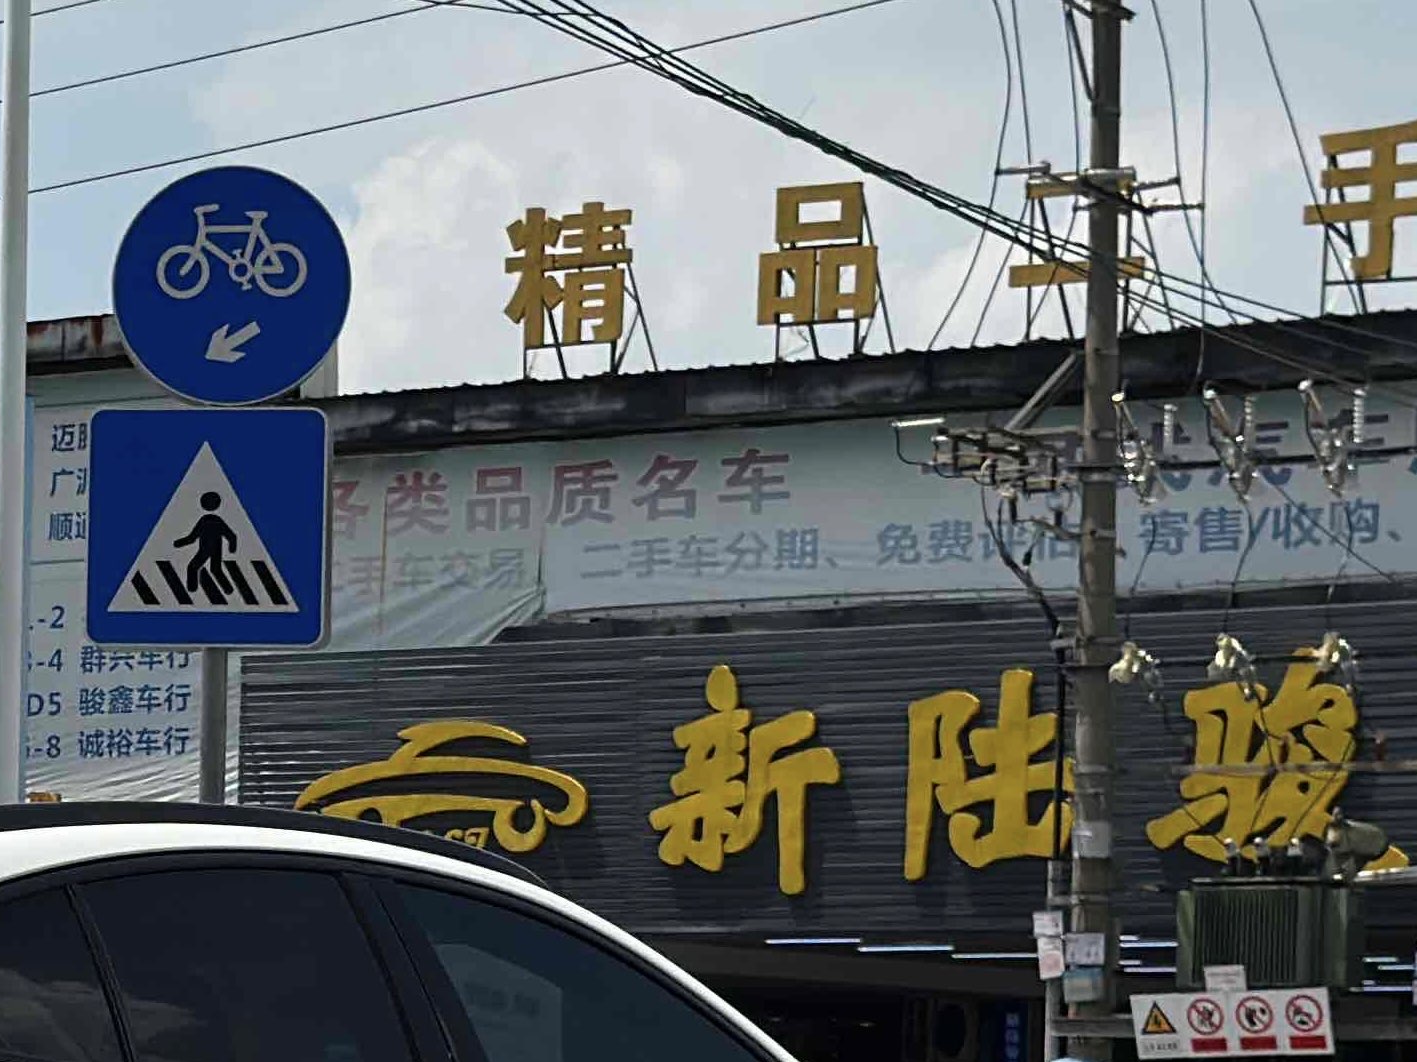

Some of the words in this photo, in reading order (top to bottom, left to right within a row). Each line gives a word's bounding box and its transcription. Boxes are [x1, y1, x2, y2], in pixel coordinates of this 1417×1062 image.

[332, 448, 791, 539] 各类品质名车
[29, 605, 66, 630] -2
[78, 683, 192, 717] 骏鑫车行
[25, 734, 62, 759] -8
[76, 727, 192, 759] 诚裕车行
[649, 646, 1410, 896] 新陆骏
